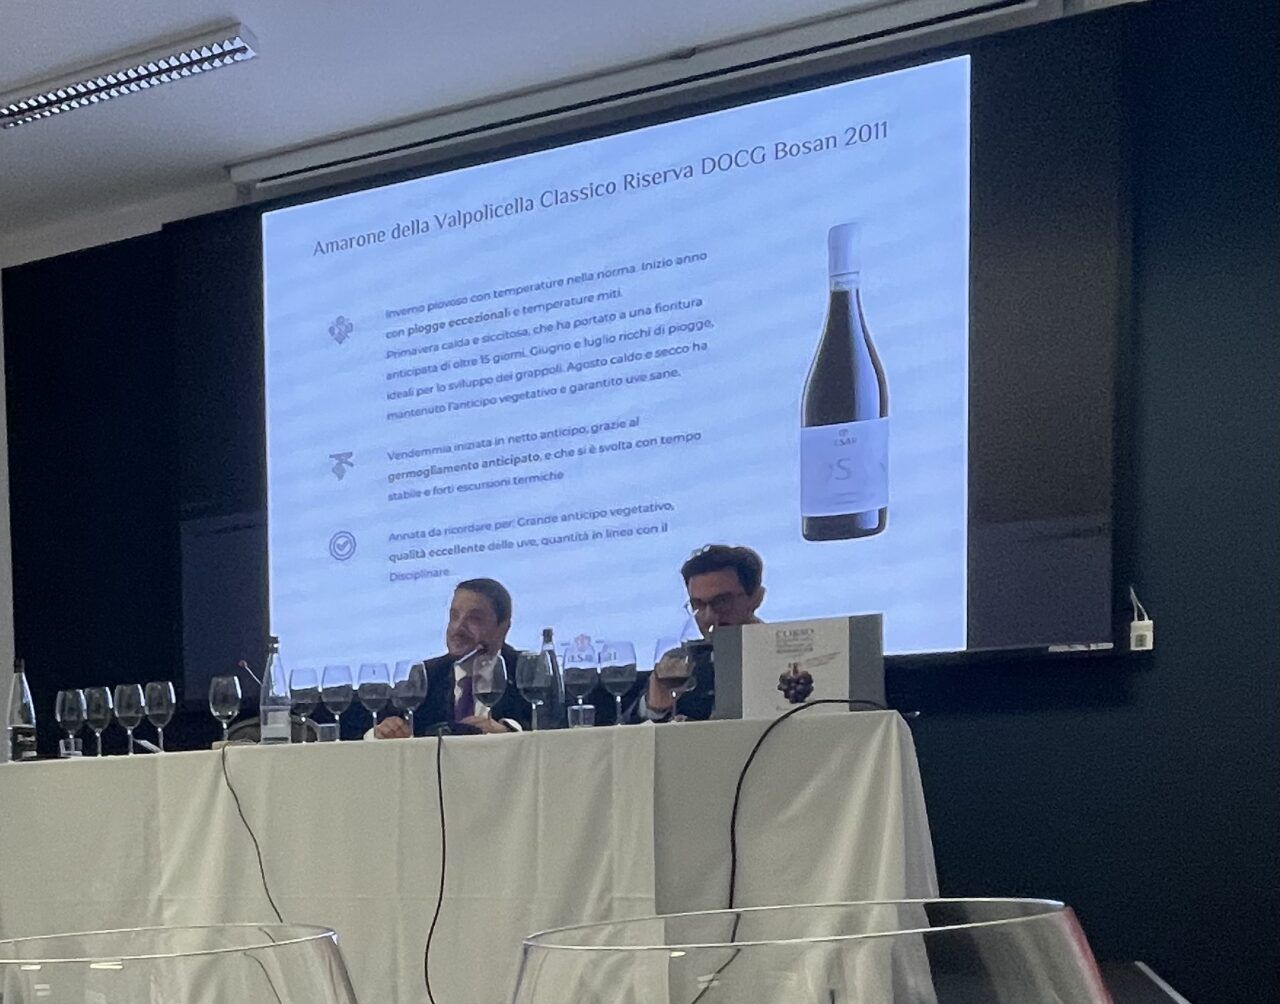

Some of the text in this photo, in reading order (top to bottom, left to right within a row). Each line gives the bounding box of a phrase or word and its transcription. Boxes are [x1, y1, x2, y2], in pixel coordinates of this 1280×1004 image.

[313, 121, 888, 256] Amarone della Valpolicella Classico Riserva DOCG Bosan 2011
[470, 292, 491, 303] con
[493, 278, 564, 299] temperature
[567, 272, 594, 286] nella
[641, 258, 673, 271] Inizio
[676, 252, 708, 264] anno
[385, 328, 405, 340] con
[407, 321, 446, 338] piogge
[448, 307, 511, 327] eccezionali
[513, 307, 520, 317] e
[522, 294, 595, 314] temperature
[386, 343, 439, 360] Primavera
[441, 338, 470, 351] calda
[472, 336, 479, 345] e
[533, 321, 554, 335] che
[556, 318, 571, 331] ha
[573, 312, 617, 329] portato
[619, 311, 626, 320] a
[629, 307, 652, 318] una
[655, 298, 703, 314] fioritura
[386, 365, 438, 381] anticipata
[440, 361, 451, 371] di
[453, 356, 478, 370] oltre
[480, 354, 490, 365] 15
[529, 341, 571, 357] Giugno
[573, 339, 581, 349] e
[584, 334, 616, 349] luglio
[618, 327, 651, 342] ricchi
[654, 325, 666, 336] di
[387, 387, 414, 401] ideali
[416, 385, 433, 397] per
[436, 382, 446, 393] lo
[448, 376, 493, 391] sviluppo
[566, 357, 608, 373] Agosto
[610, 352, 642, 365] caldo
[645, 350, 653, 360] e
[655, 345, 690, 358] secco
[692, 341, 708, 352] ha
[387, 404, 447, 421] mantenuto
[499, 387, 558, 405] vegetativo
[560, 385, 567, 394] e
[569, 377, 623, 394] garantito
[626, 373, 647, 385] uve
[387, 445, 452, 461] Vendemmia
[454, 439, 492, 452] iniziata
[494, 436, 505, 446] in
[507, 432, 538, 445] netto
[591, 419, 626, 435] grazie
[628, 416, 640, 428] al
[388, 461, 479, 483] germogliamento
[544, 451, 552, 461] e
[554, 448, 575, 459] che
[577, 446, 587, 456] si
[599, 441, 633, 454] svolta
[635, 437, 658, 449] con
[660, 432, 702, 445] tempo
[388, 488, 422, 502] stabile
[433, 485, 455, 496] forti
[456, 479, 511, 493] escursioni
[513, 471, 564, 486] termiche
[388, 528, 427, 542] Annata
[428, 526, 442, 538] da
[444, 521, 492, 536] ricordare
[516, 514, 559, 527] Grande
[561, 508, 608, 522] anticipo
[388, 548, 427, 564] qualità
[428, 541, 486, 557] eccellente
[487, 539, 514, 551] delle
[541, 531, 589, 547] quantità
[592, 529, 603, 540] in
[605, 527, 634, 539] linea
[636, 525, 659, 536] con
[661, 522, 669, 533] il
[389, 567, 450, 582] Disciplinare
